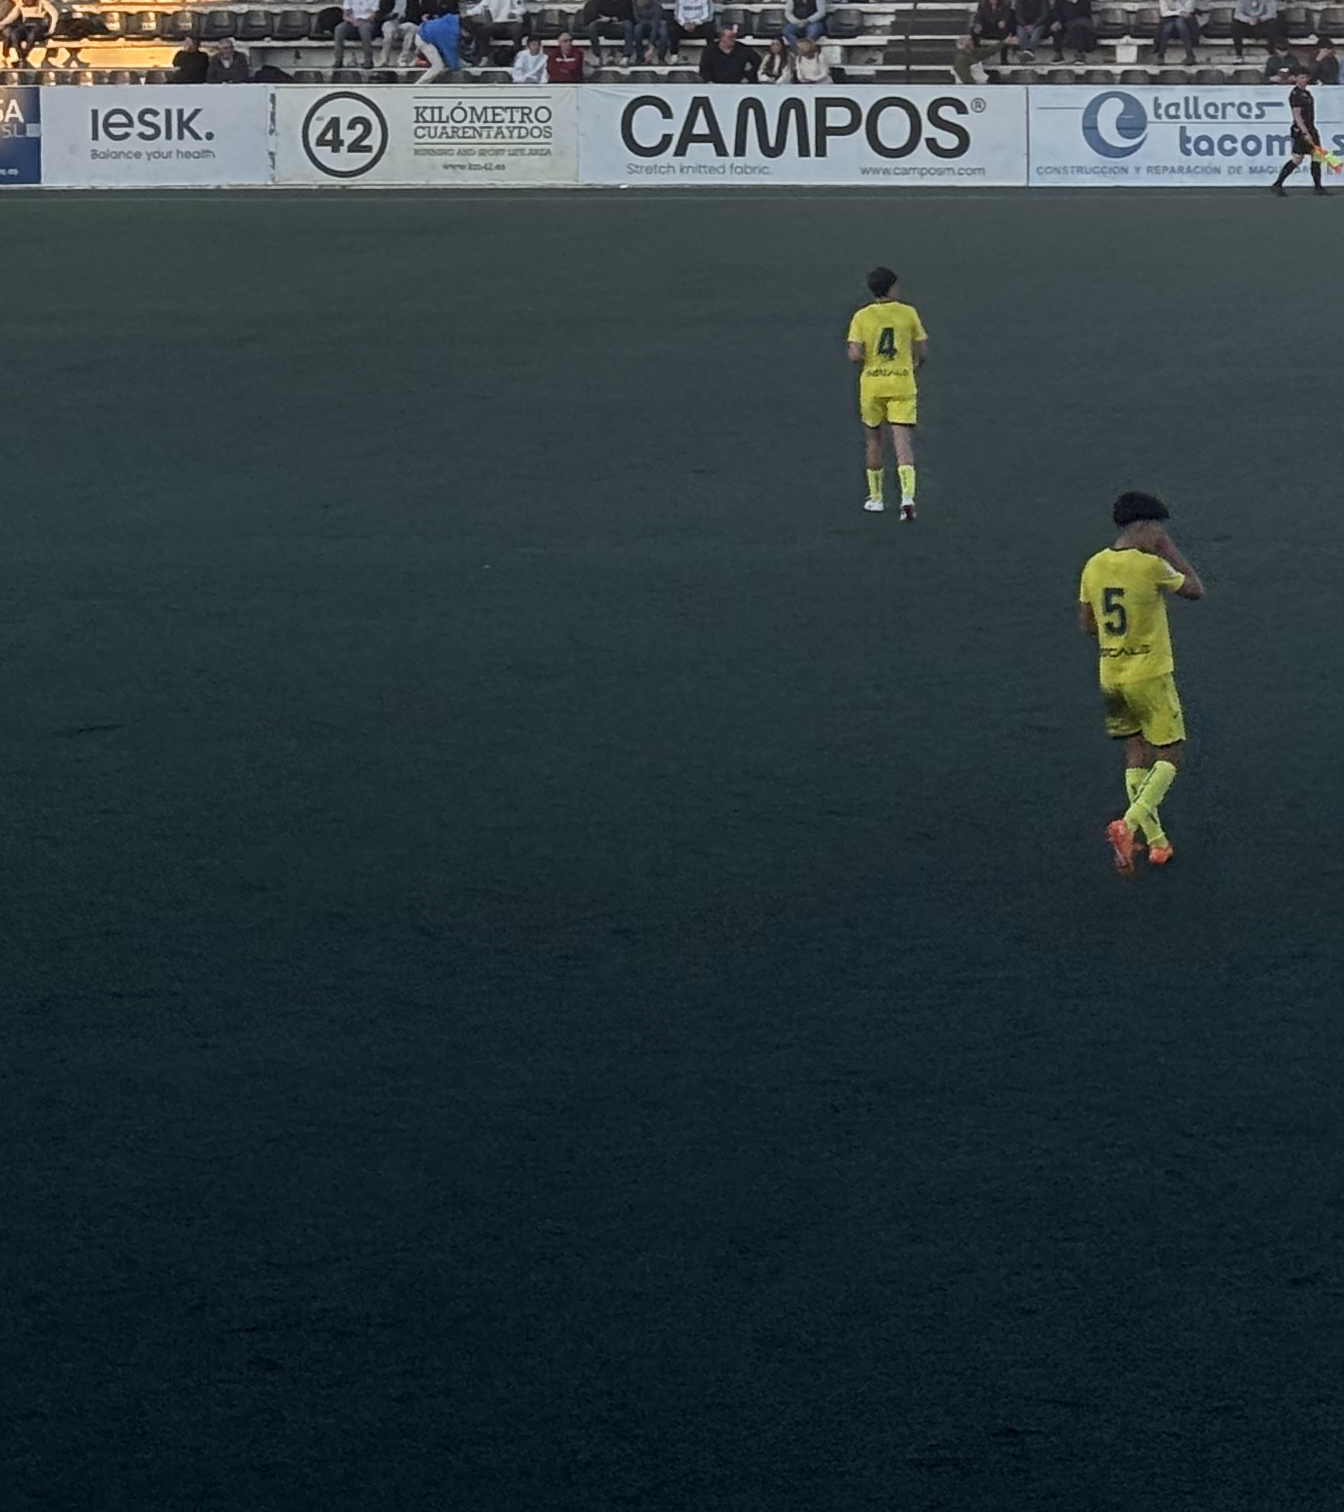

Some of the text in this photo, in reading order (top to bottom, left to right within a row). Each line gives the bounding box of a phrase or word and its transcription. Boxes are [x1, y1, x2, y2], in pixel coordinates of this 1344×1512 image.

[413, 101, 552, 124] KILÓMETRO
[1154, 96, 1284, 120] talleres
[315, 116, 373, 153] 42
[413, 126, 552, 139] CUARENTAYDOS
[621, 95, 971, 159] CAMPOS
[90, 149, 215, 161] Balance your health
[627, 162, 676, 175] Stretch
[679, 163, 725, 176] knitted
[860, 166, 986, 178] www.camposm.com
[1135, 164, 1142, 175] Y
[1228, 164, 1243, 175] DE
[877, 327, 897, 361] 4
[1103, 587, 1128, 637] 5
